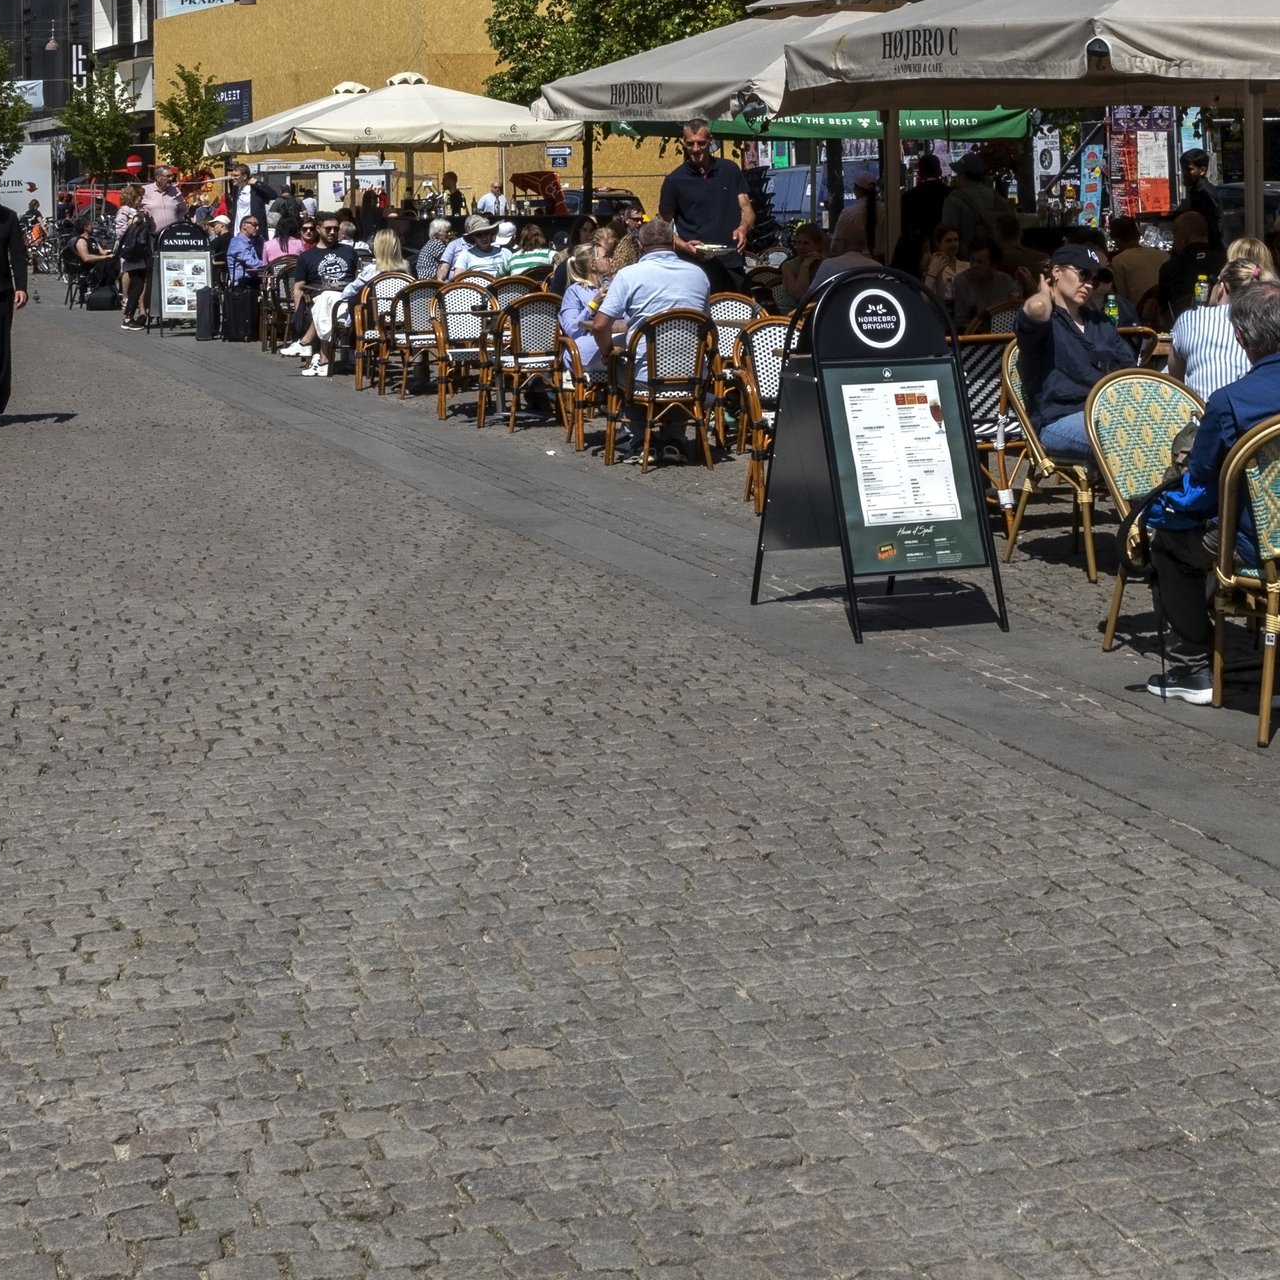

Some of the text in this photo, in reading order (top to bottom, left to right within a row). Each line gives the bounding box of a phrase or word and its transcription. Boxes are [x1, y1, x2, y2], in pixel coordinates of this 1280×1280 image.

[882, 27, 959, 60] HØJBRO C
[610, 82, 663, 107] HØJBRO C
[858, 315, 896, 323] NØRREBRO
[862, 322, 895, 330] BRYGHUS
